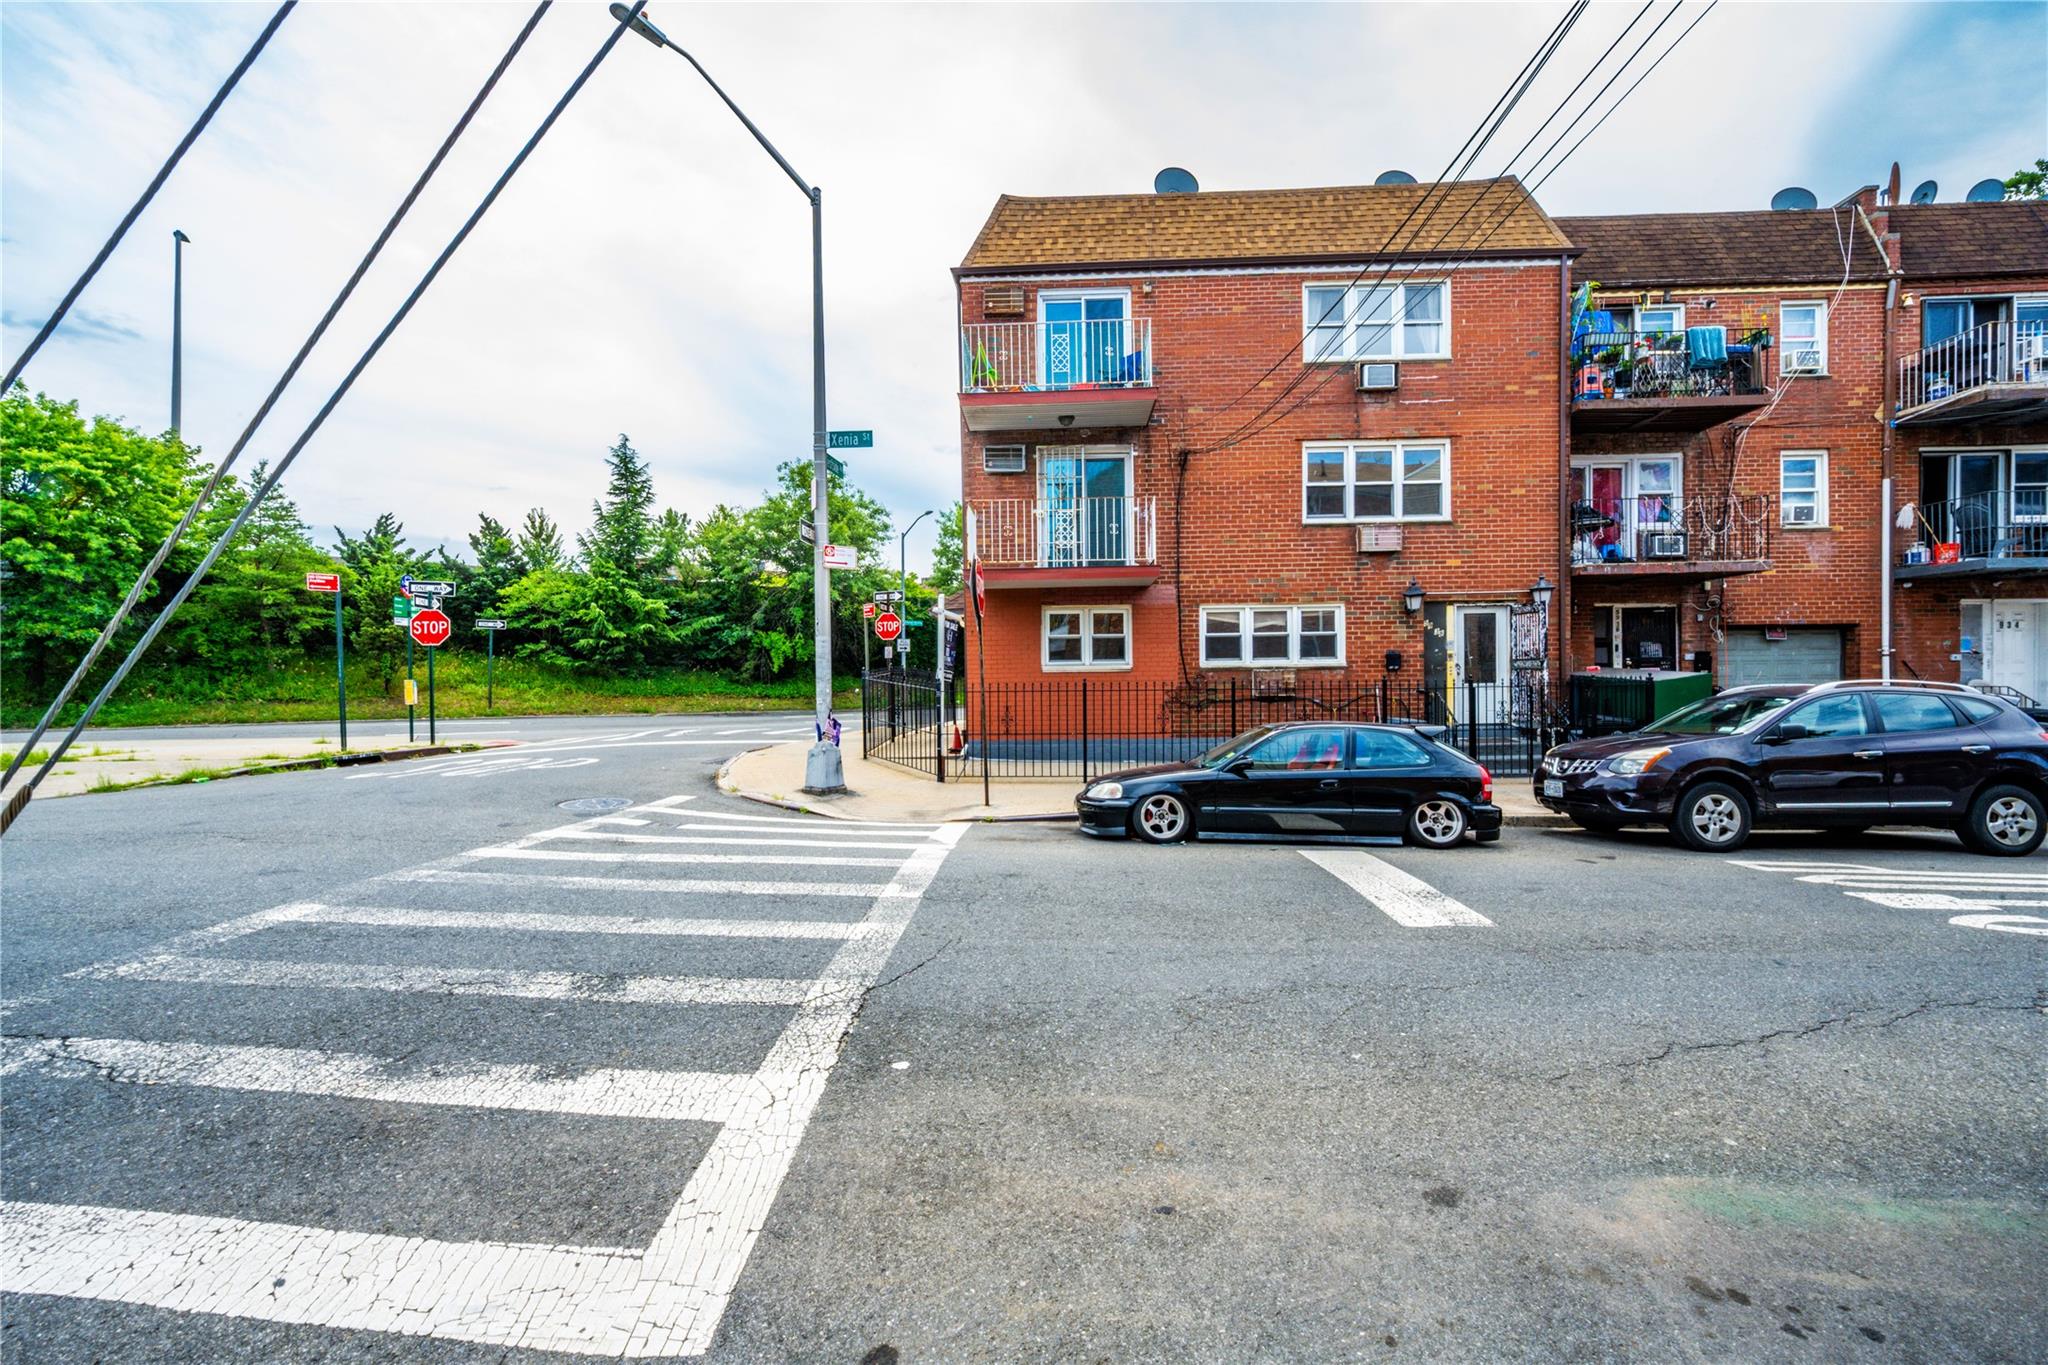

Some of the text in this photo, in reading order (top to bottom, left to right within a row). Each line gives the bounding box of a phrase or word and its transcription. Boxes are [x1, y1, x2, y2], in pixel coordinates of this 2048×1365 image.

[831, 432, 871, 446] Xenia St
[413, 620, 448, 635] STOP
[877, 620, 900, 632] STOP
